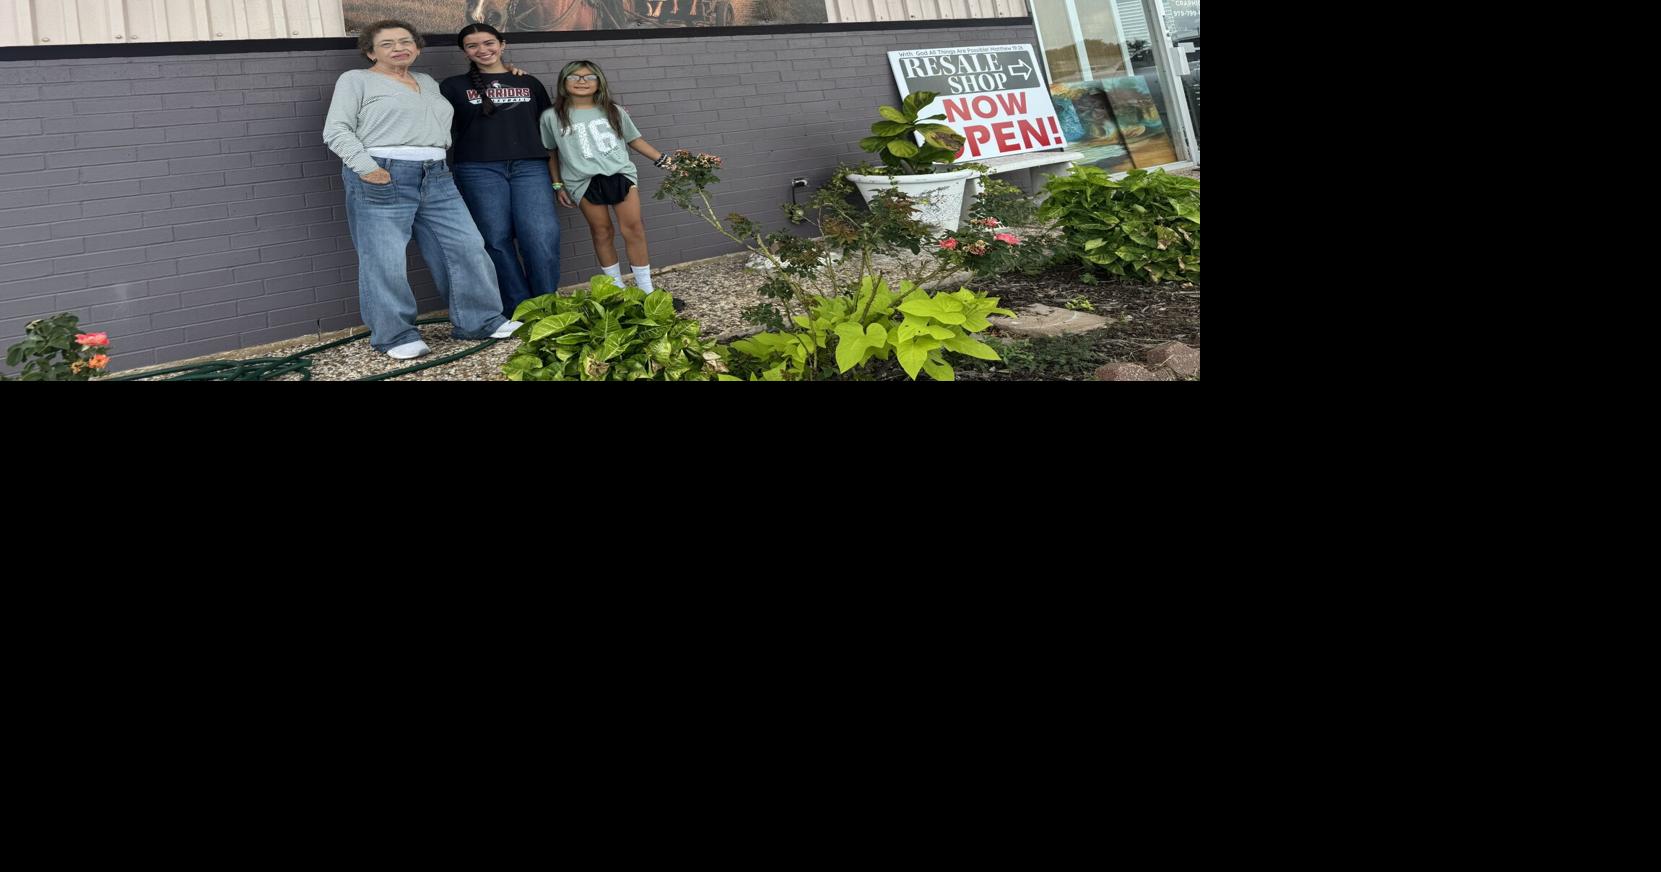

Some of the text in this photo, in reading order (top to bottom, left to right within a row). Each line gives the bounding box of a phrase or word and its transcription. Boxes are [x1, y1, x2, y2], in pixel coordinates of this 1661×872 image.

[902, 52, 1003, 79] RESALE
[947, 73, 1008, 95] SHOP
[942, 91, 1028, 123] NOW
[952, 116, 1063, 159] PEN!
